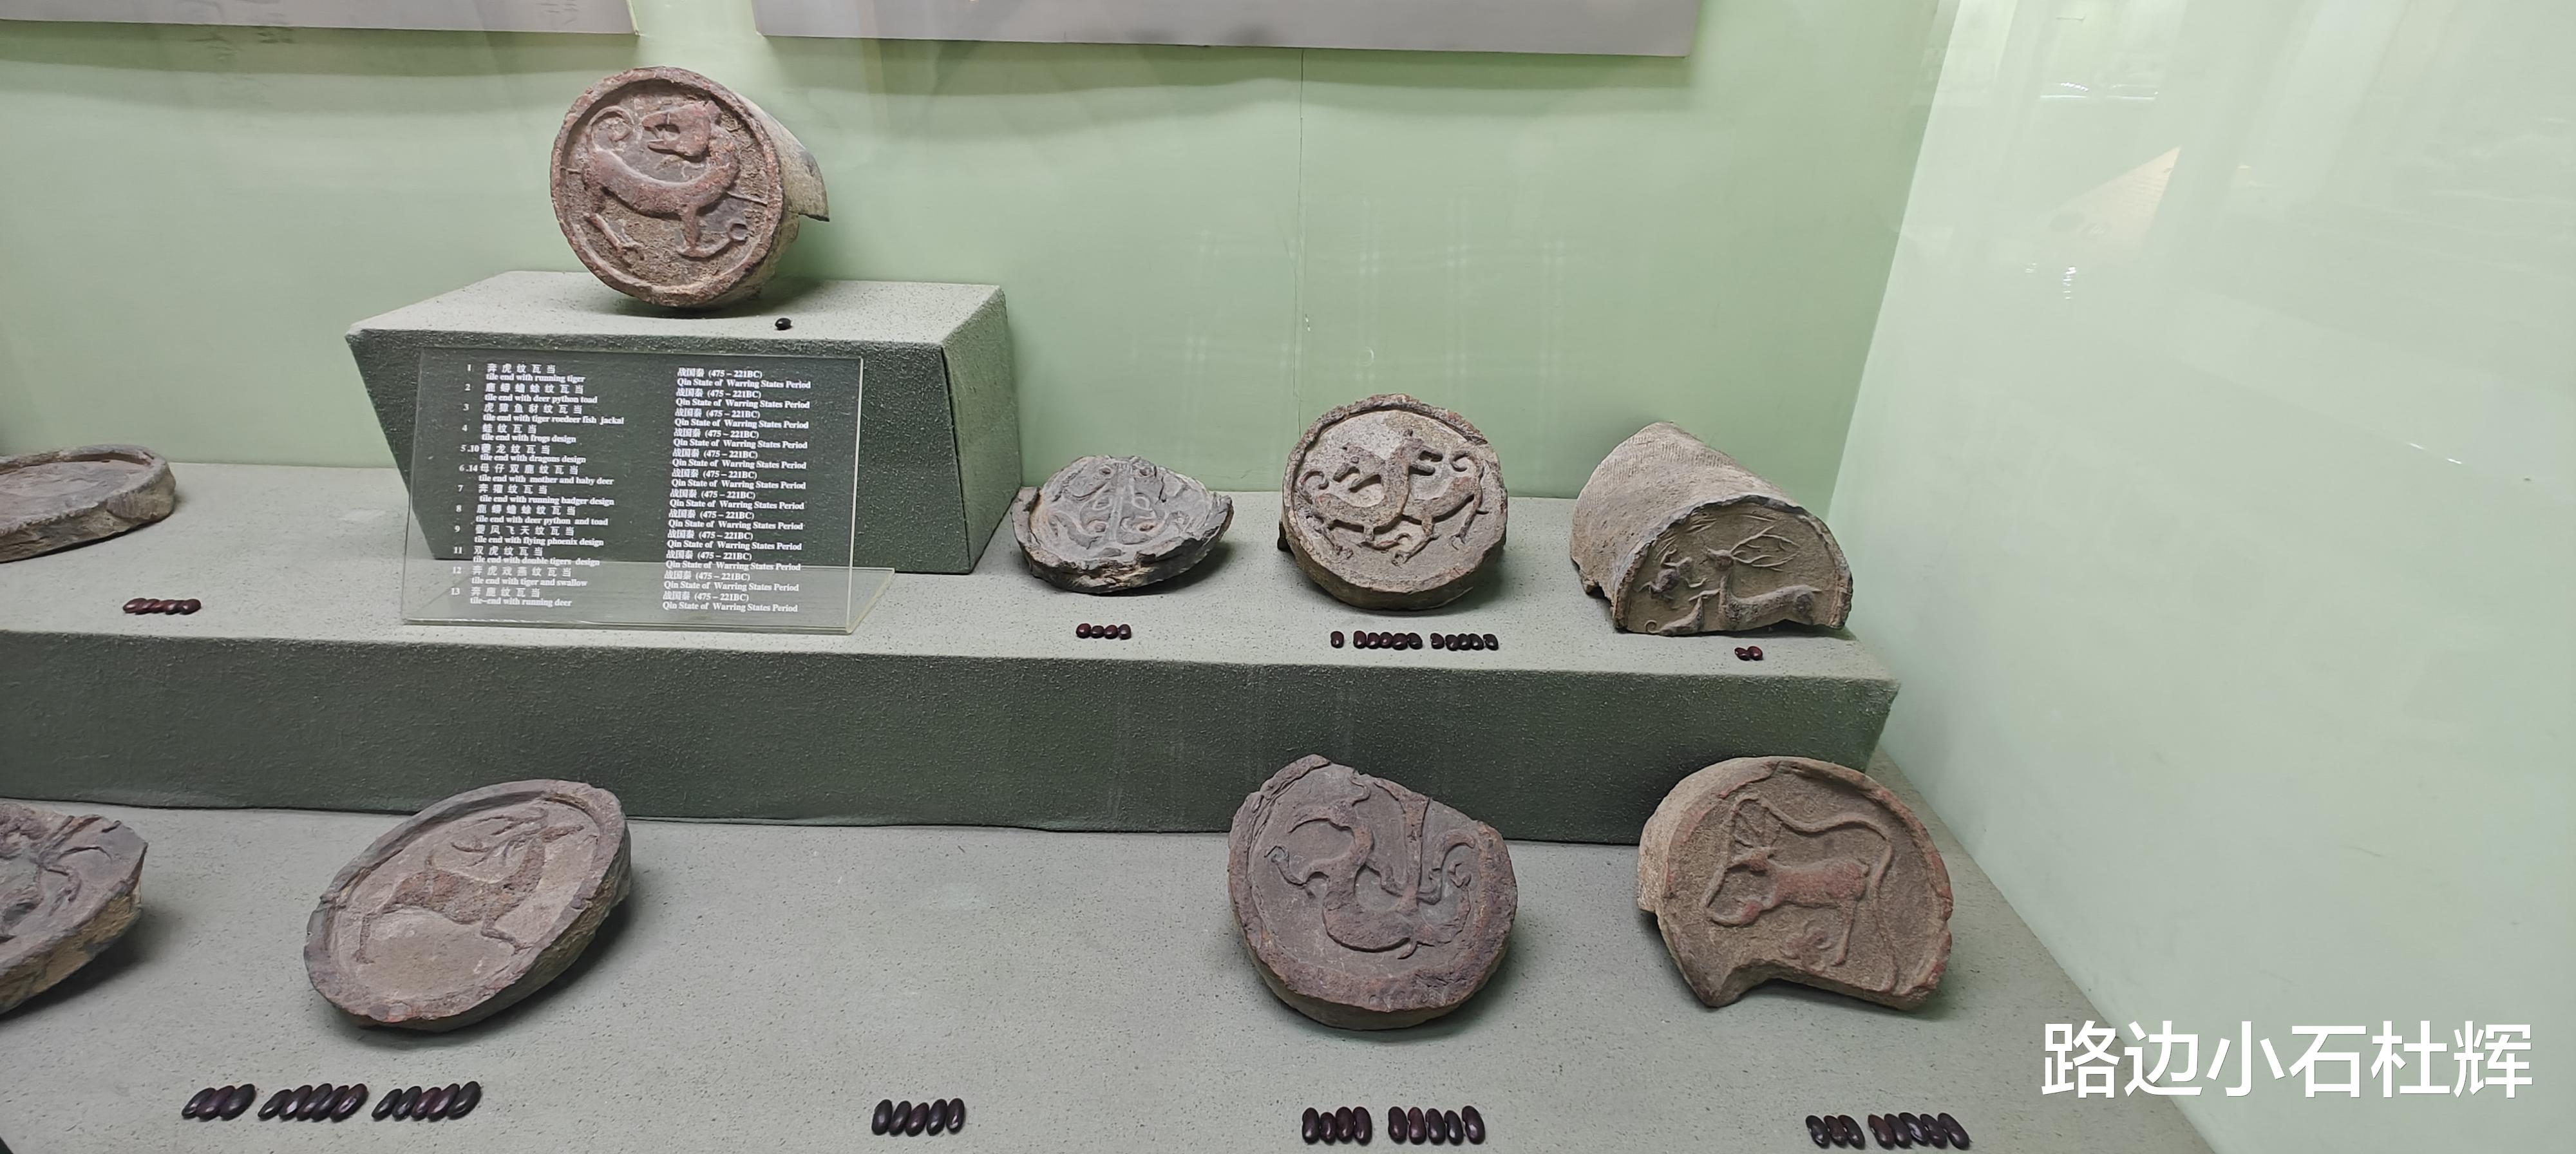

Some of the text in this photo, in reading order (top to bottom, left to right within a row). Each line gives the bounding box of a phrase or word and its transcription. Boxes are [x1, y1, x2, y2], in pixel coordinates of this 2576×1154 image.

[487, 363, 555, 373] 奔虎纹瓦当
[677, 368, 704, 377] 战国秦
[734, 370, 762, 378] 221BC)
[535, 374, 565, 383] running
[567, 375, 585, 383] tiger
[677, 377, 691, 386] Qin
[726, 379, 759, 388] Warring
[786, 380, 811, 388] Period
[675, 397, 690, 406] Qin
[725, 399, 758, 408] Warring
[531, 415, 551, 423] tiger
[530, 434, 550, 443] frogs
[551, 435, 576, 444] design
[673, 438, 687, 446] Qin
[723, 439, 756, 449] Warring
[529, 455, 560, 463] dragons
[561, 455, 586, 464] design
[480, 463, 578, 474] 母仔双鹿纹瓦当
[671, 468, 698, 477] 战国秦
[728, 471, 757, 479] 221BC)
[576, 477, 595, 485] baby
[671, 478, 685, 487] Qin
[721, 480, 754, 489] Warring
[528, 497, 560, 505] running
[560, 497, 589, 506] badger
[588, 497, 614, 506] design
[668, 519, 682, 527] Qin
[718, 520, 751, 530] Warring
[523, 536, 545, 545] flying
[547, 537, 578, 545] phoenix
[578, 538, 603, 547] design
[473, 545, 543, 556] 双虎纹瓦当
[549, 557, 571, 565] tigers
[574, 558, 600, 567] design
[665, 560, 680, 569] Qin
[715, 562, 749, 571] Warring
[520, 578, 539, 586] tiger
[471, 587, 540, 597] 奔鹿纹瓦当
[663, 591, 689, 600] 战国秦
[521, 598, 553, 607] running
[662, 601, 677, 610] Qin
[712, 602, 746, 612] Warring
